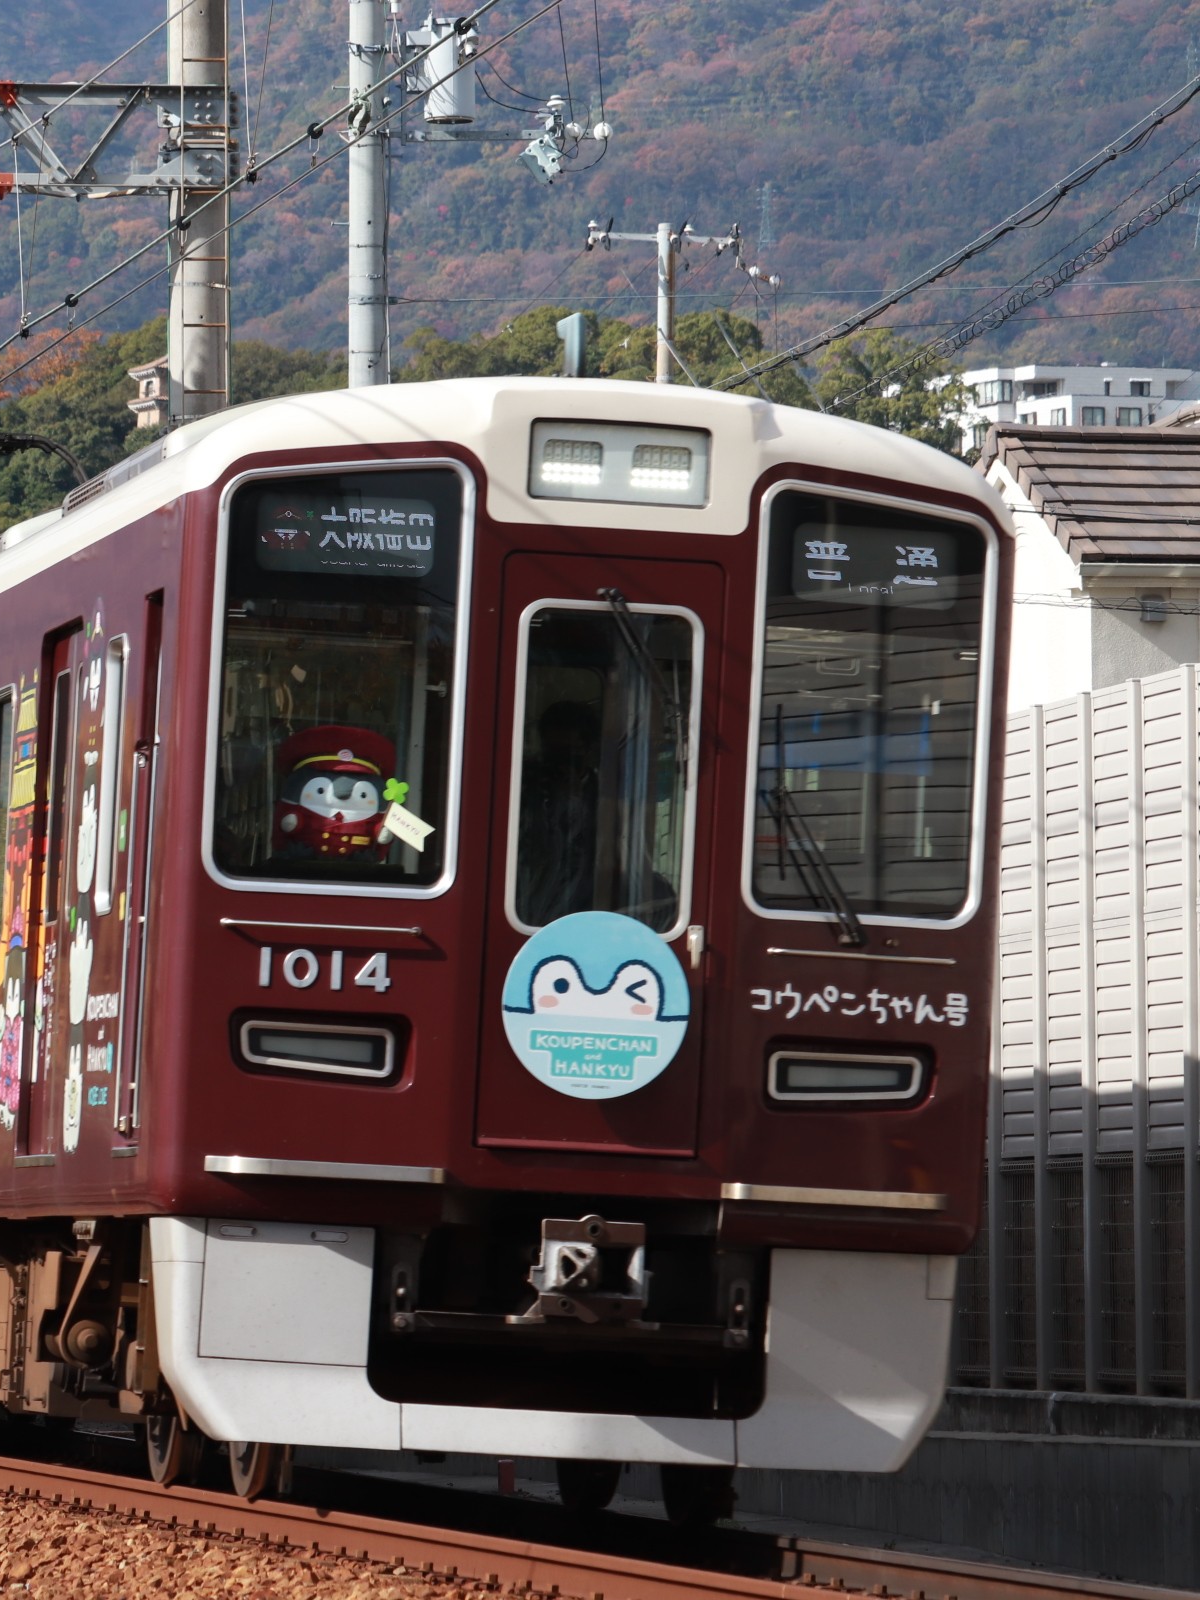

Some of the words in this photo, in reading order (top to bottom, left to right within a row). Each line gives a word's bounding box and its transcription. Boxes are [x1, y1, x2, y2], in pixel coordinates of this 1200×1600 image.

[258, 946, 392, 993] 1014
[750, 982, 969, 1027] コウペンちゃん号
[535, 1033, 653, 1053] KOUPENCHAN
[584, 1053, 603, 1061] and
[555, 1059, 631, 1077] HANKYU
